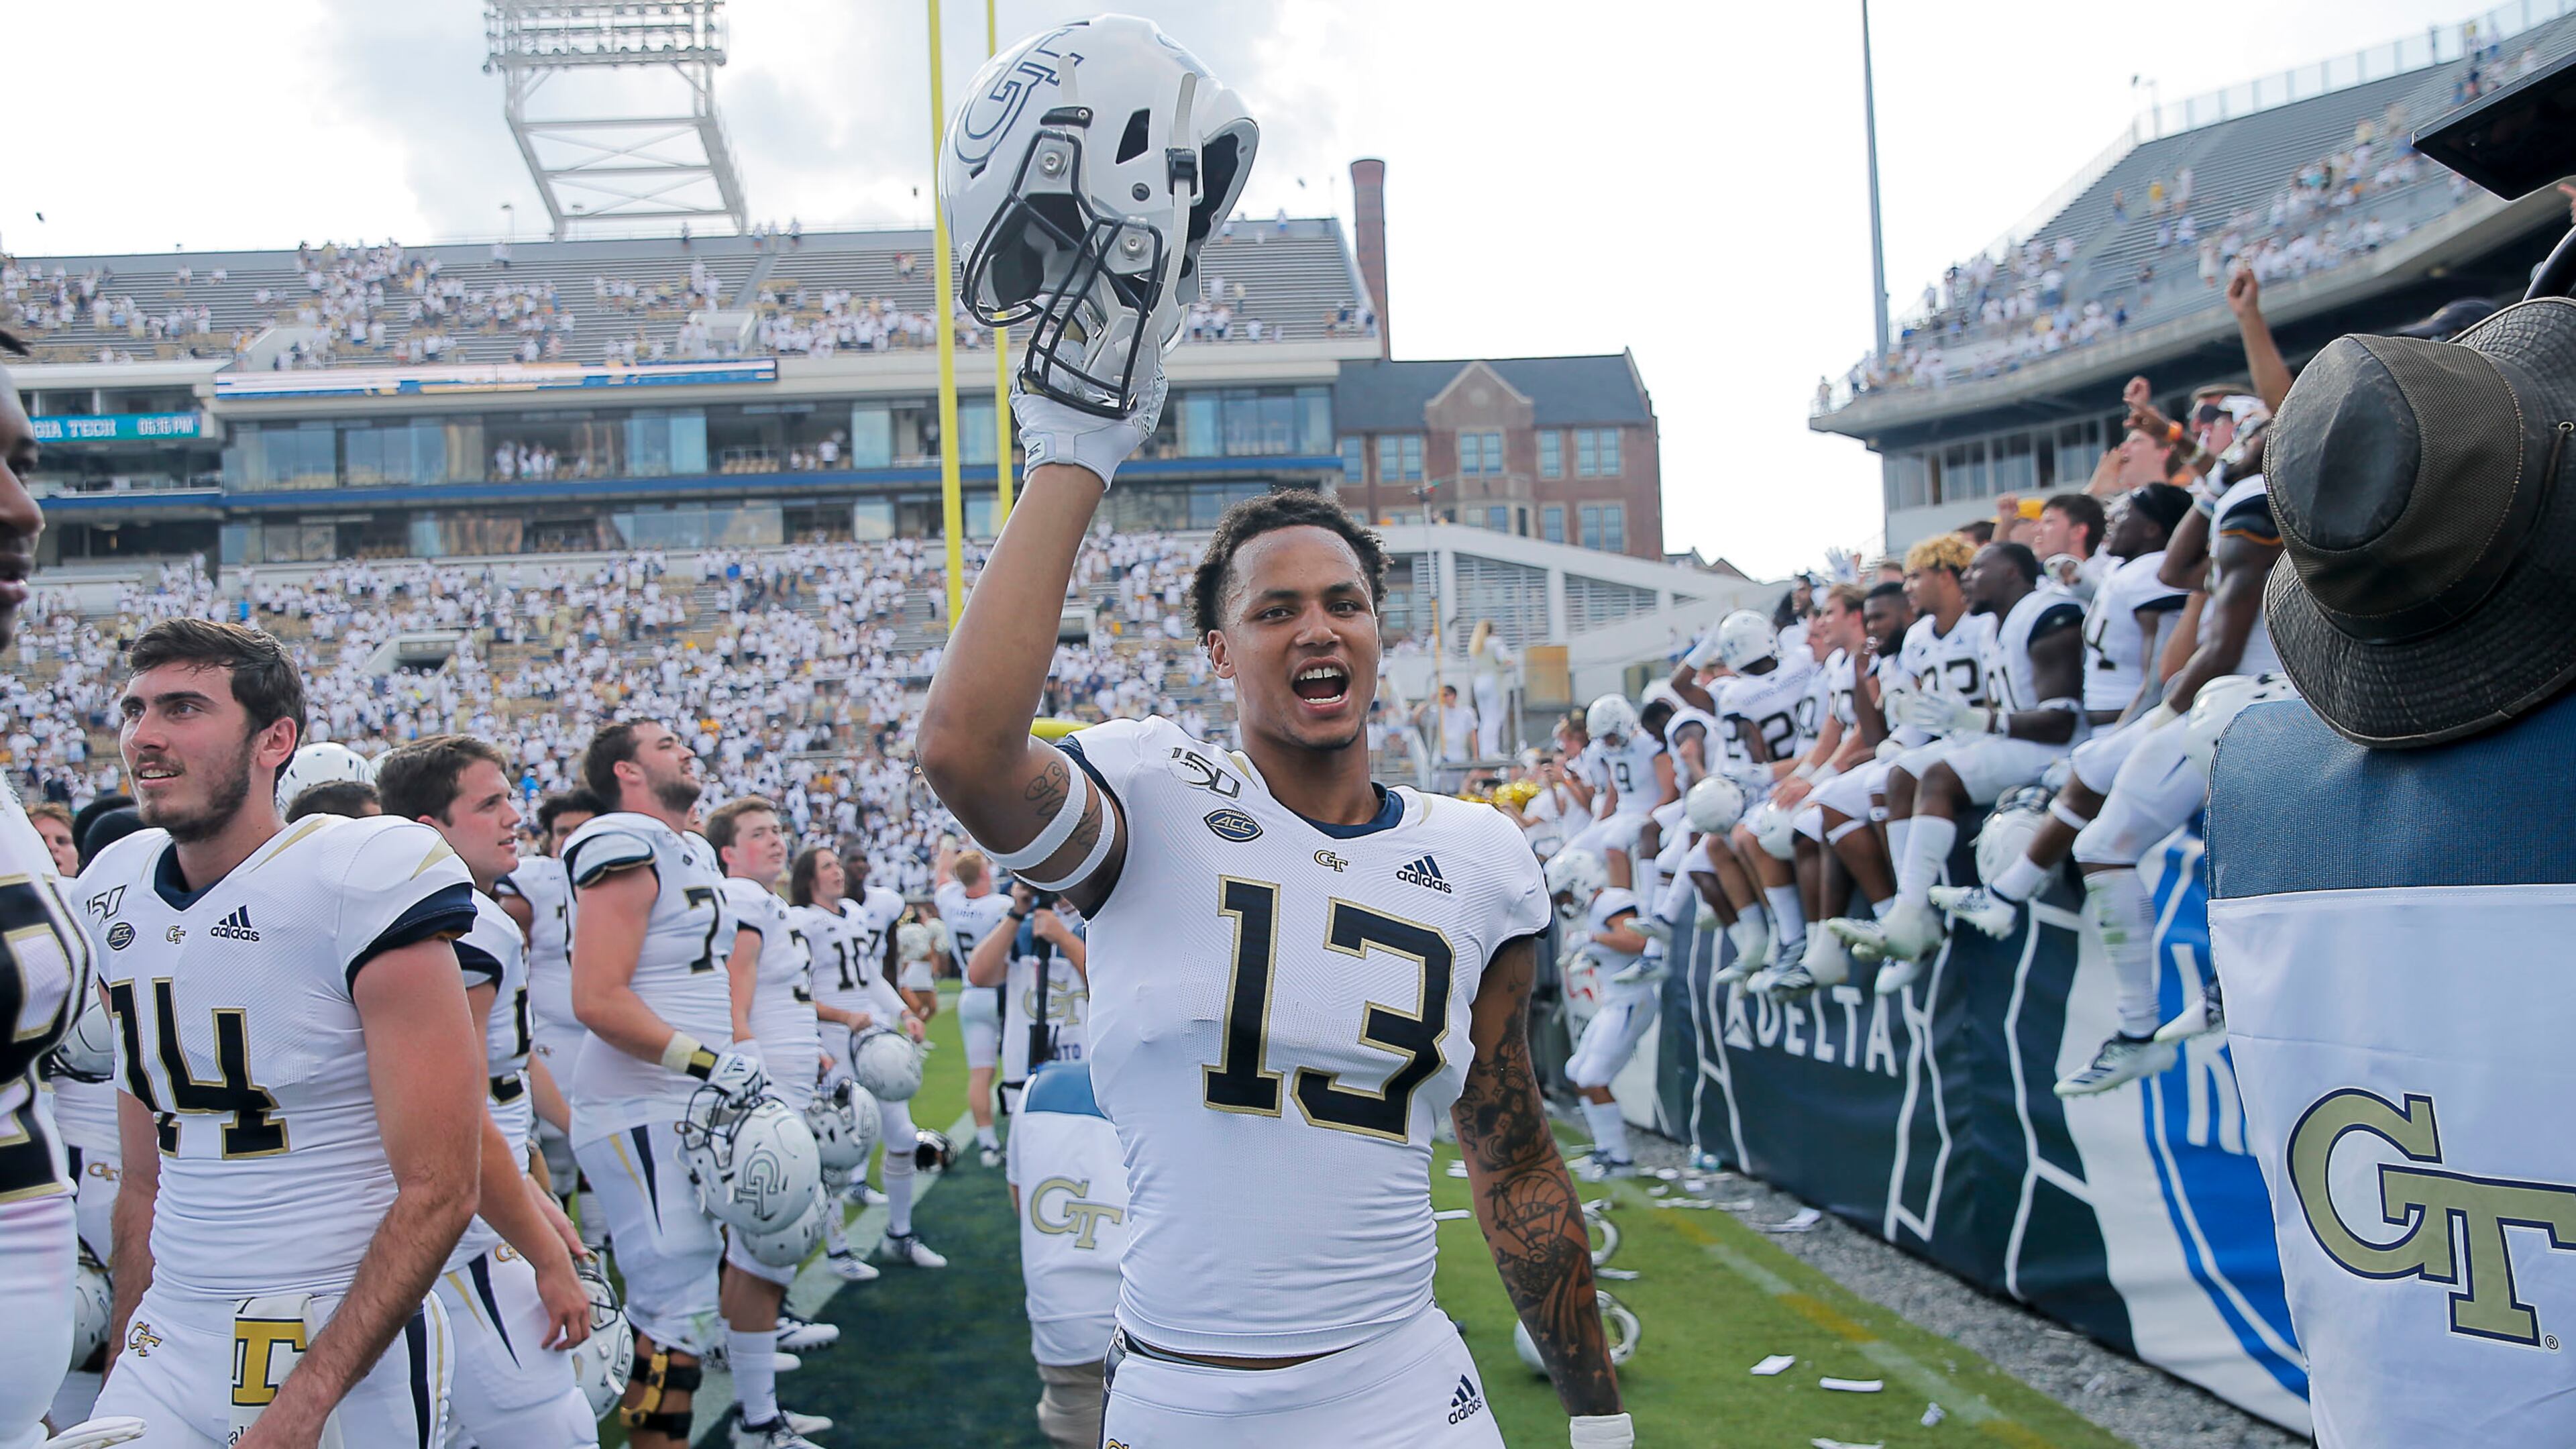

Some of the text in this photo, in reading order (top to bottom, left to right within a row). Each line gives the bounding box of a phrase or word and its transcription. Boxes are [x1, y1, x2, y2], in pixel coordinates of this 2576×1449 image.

[68, 419, 117, 437] TECH
[172, 416, 193, 433] PM
[1171, 747, 1240, 798] 150
[1213, 816, 1254, 833] ACC
[1313, 849, 1348, 873] GT
[1395, 869, 1452, 894] adidas
[111, 926, 131, 942] ACC
[166, 925, 186, 944] GT
[211, 925, 260, 943] adidas
[683, 885, 728, 975] 7
[1203, 874, 1456, 1144] 13
[109, 977, 290, 1159] 14
[1030, 1177, 1124, 1250] GT
[2286, 1087, 2576, 1348] GT
[1448, 1396, 1482, 1425] adidas
